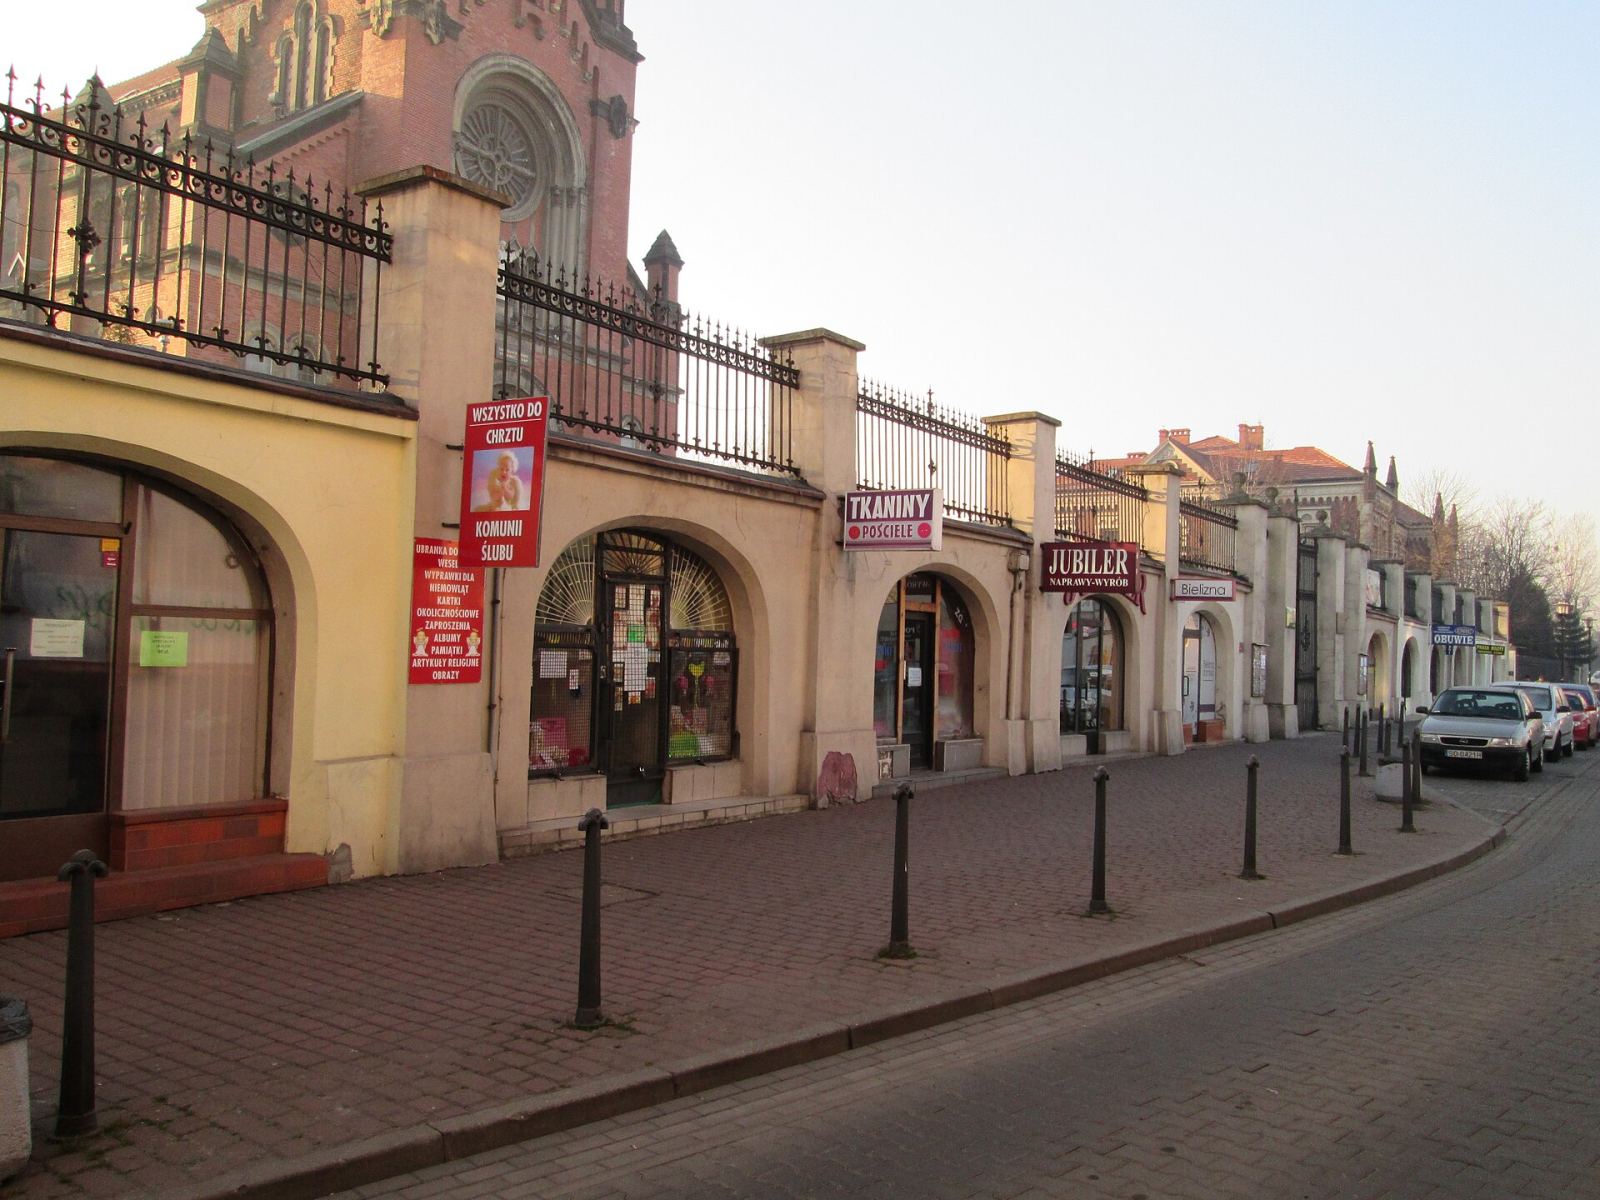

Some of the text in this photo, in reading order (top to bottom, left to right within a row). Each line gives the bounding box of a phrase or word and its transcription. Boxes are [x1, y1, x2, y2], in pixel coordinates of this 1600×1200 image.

[473, 401, 542, 422] WSZYSTKO DO
[486, 427, 524, 444] CHRZTU
[850, 493, 930, 519] TKANINY
[475, 519, 523, 537] KOMUNII
[862, 523, 913, 538] POŚCIELE
[416, 544, 458, 556] UBRANKA DO
[481, 540, 514, 561] ŚLUBU
[437, 558, 459, 569] WESEL
[1049, 548, 1129, 575] JUBILER
[424, 570, 475, 582] WYPRAWKI DLA
[1049, 576, 1129, 587] NAPRAWY-WYRÓB
[429, 583, 469, 596] NIEMOWLĄT
[1181, 583, 1226, 596] Bielizna
[436, 596, 461, 606] KARTKI
[416, 607, 480, 619] OKOLICZNOŚCIOWE
[425, 620, 471, 631] ZAPROSZENIA
[433, 633, 462, 643] ALBUMY
[1434, 634, 1474, 645] OBUWIE
[431, 645, 463, 657] PAMIĄTKI
[412, 658, 479, 668] ARTYKUŁY RELIGIJNE
[432, 670, 460, 680] OBRAZY
